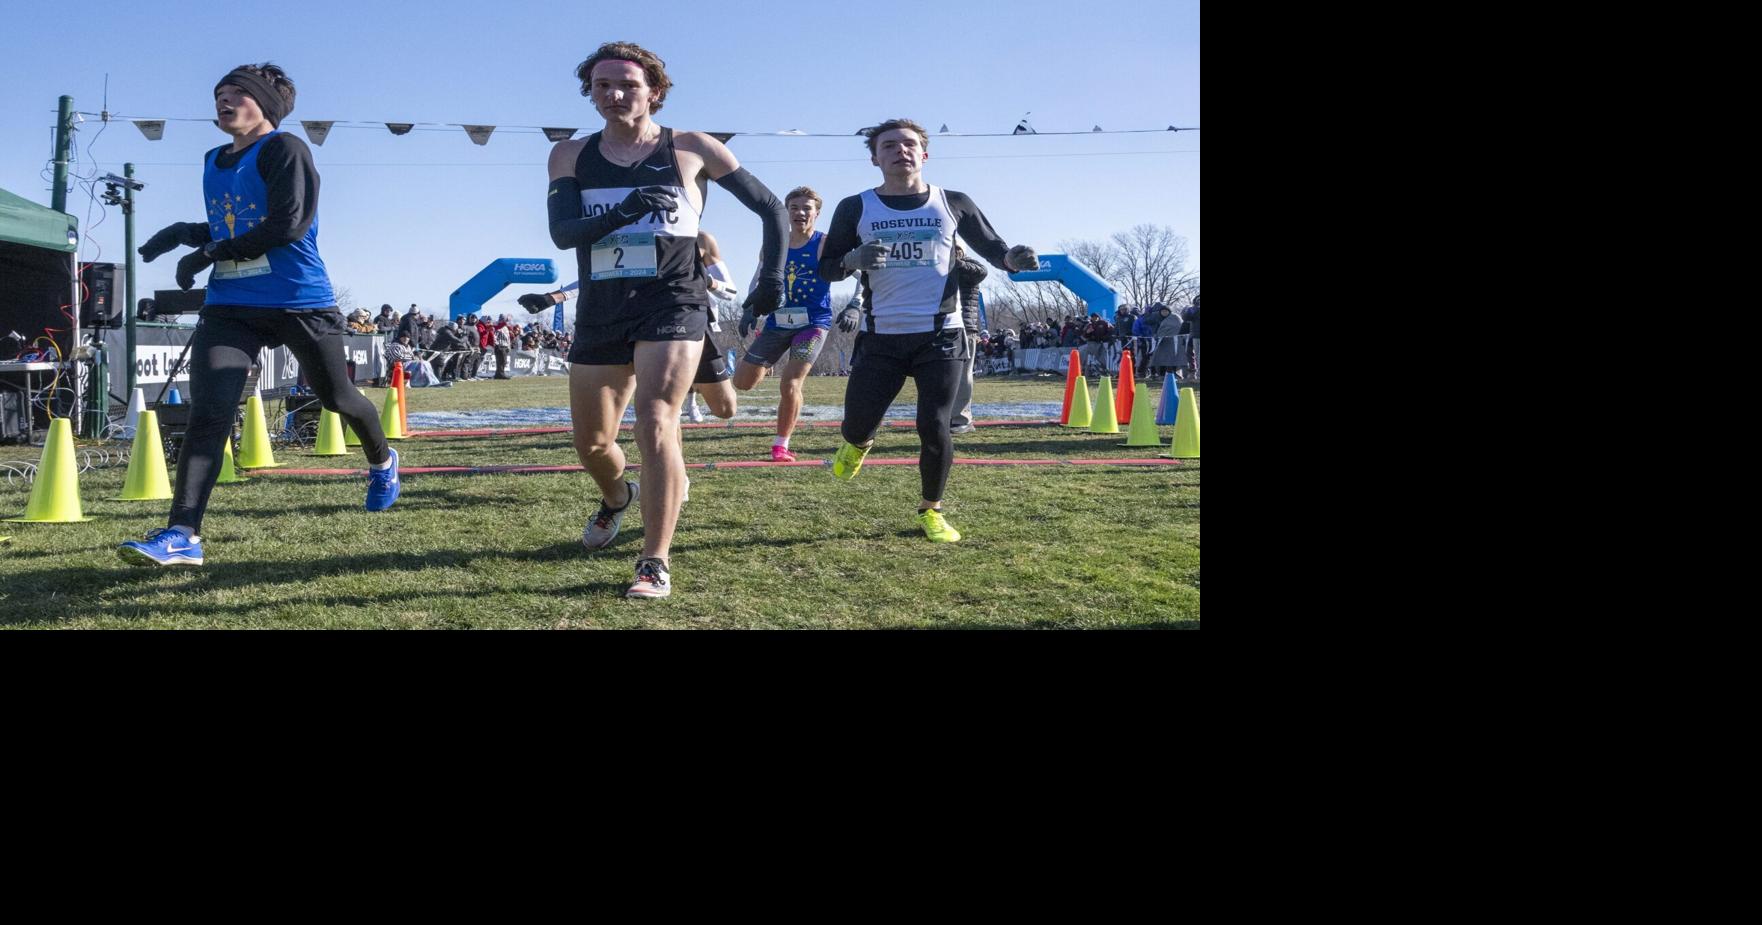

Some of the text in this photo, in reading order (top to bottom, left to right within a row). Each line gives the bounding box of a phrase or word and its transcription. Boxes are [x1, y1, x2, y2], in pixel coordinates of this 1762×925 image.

[871, 218, 942, 231] ROSEVILLE
[890, 242, 923, 260] 405
[613, 247, 625, 269] 2
[513, 263, 546, 271] HOKA
[787, 314, 794, 325] 4
[136, 353, 159, 377] oot
[514, 358, 531, 369] HOKA
